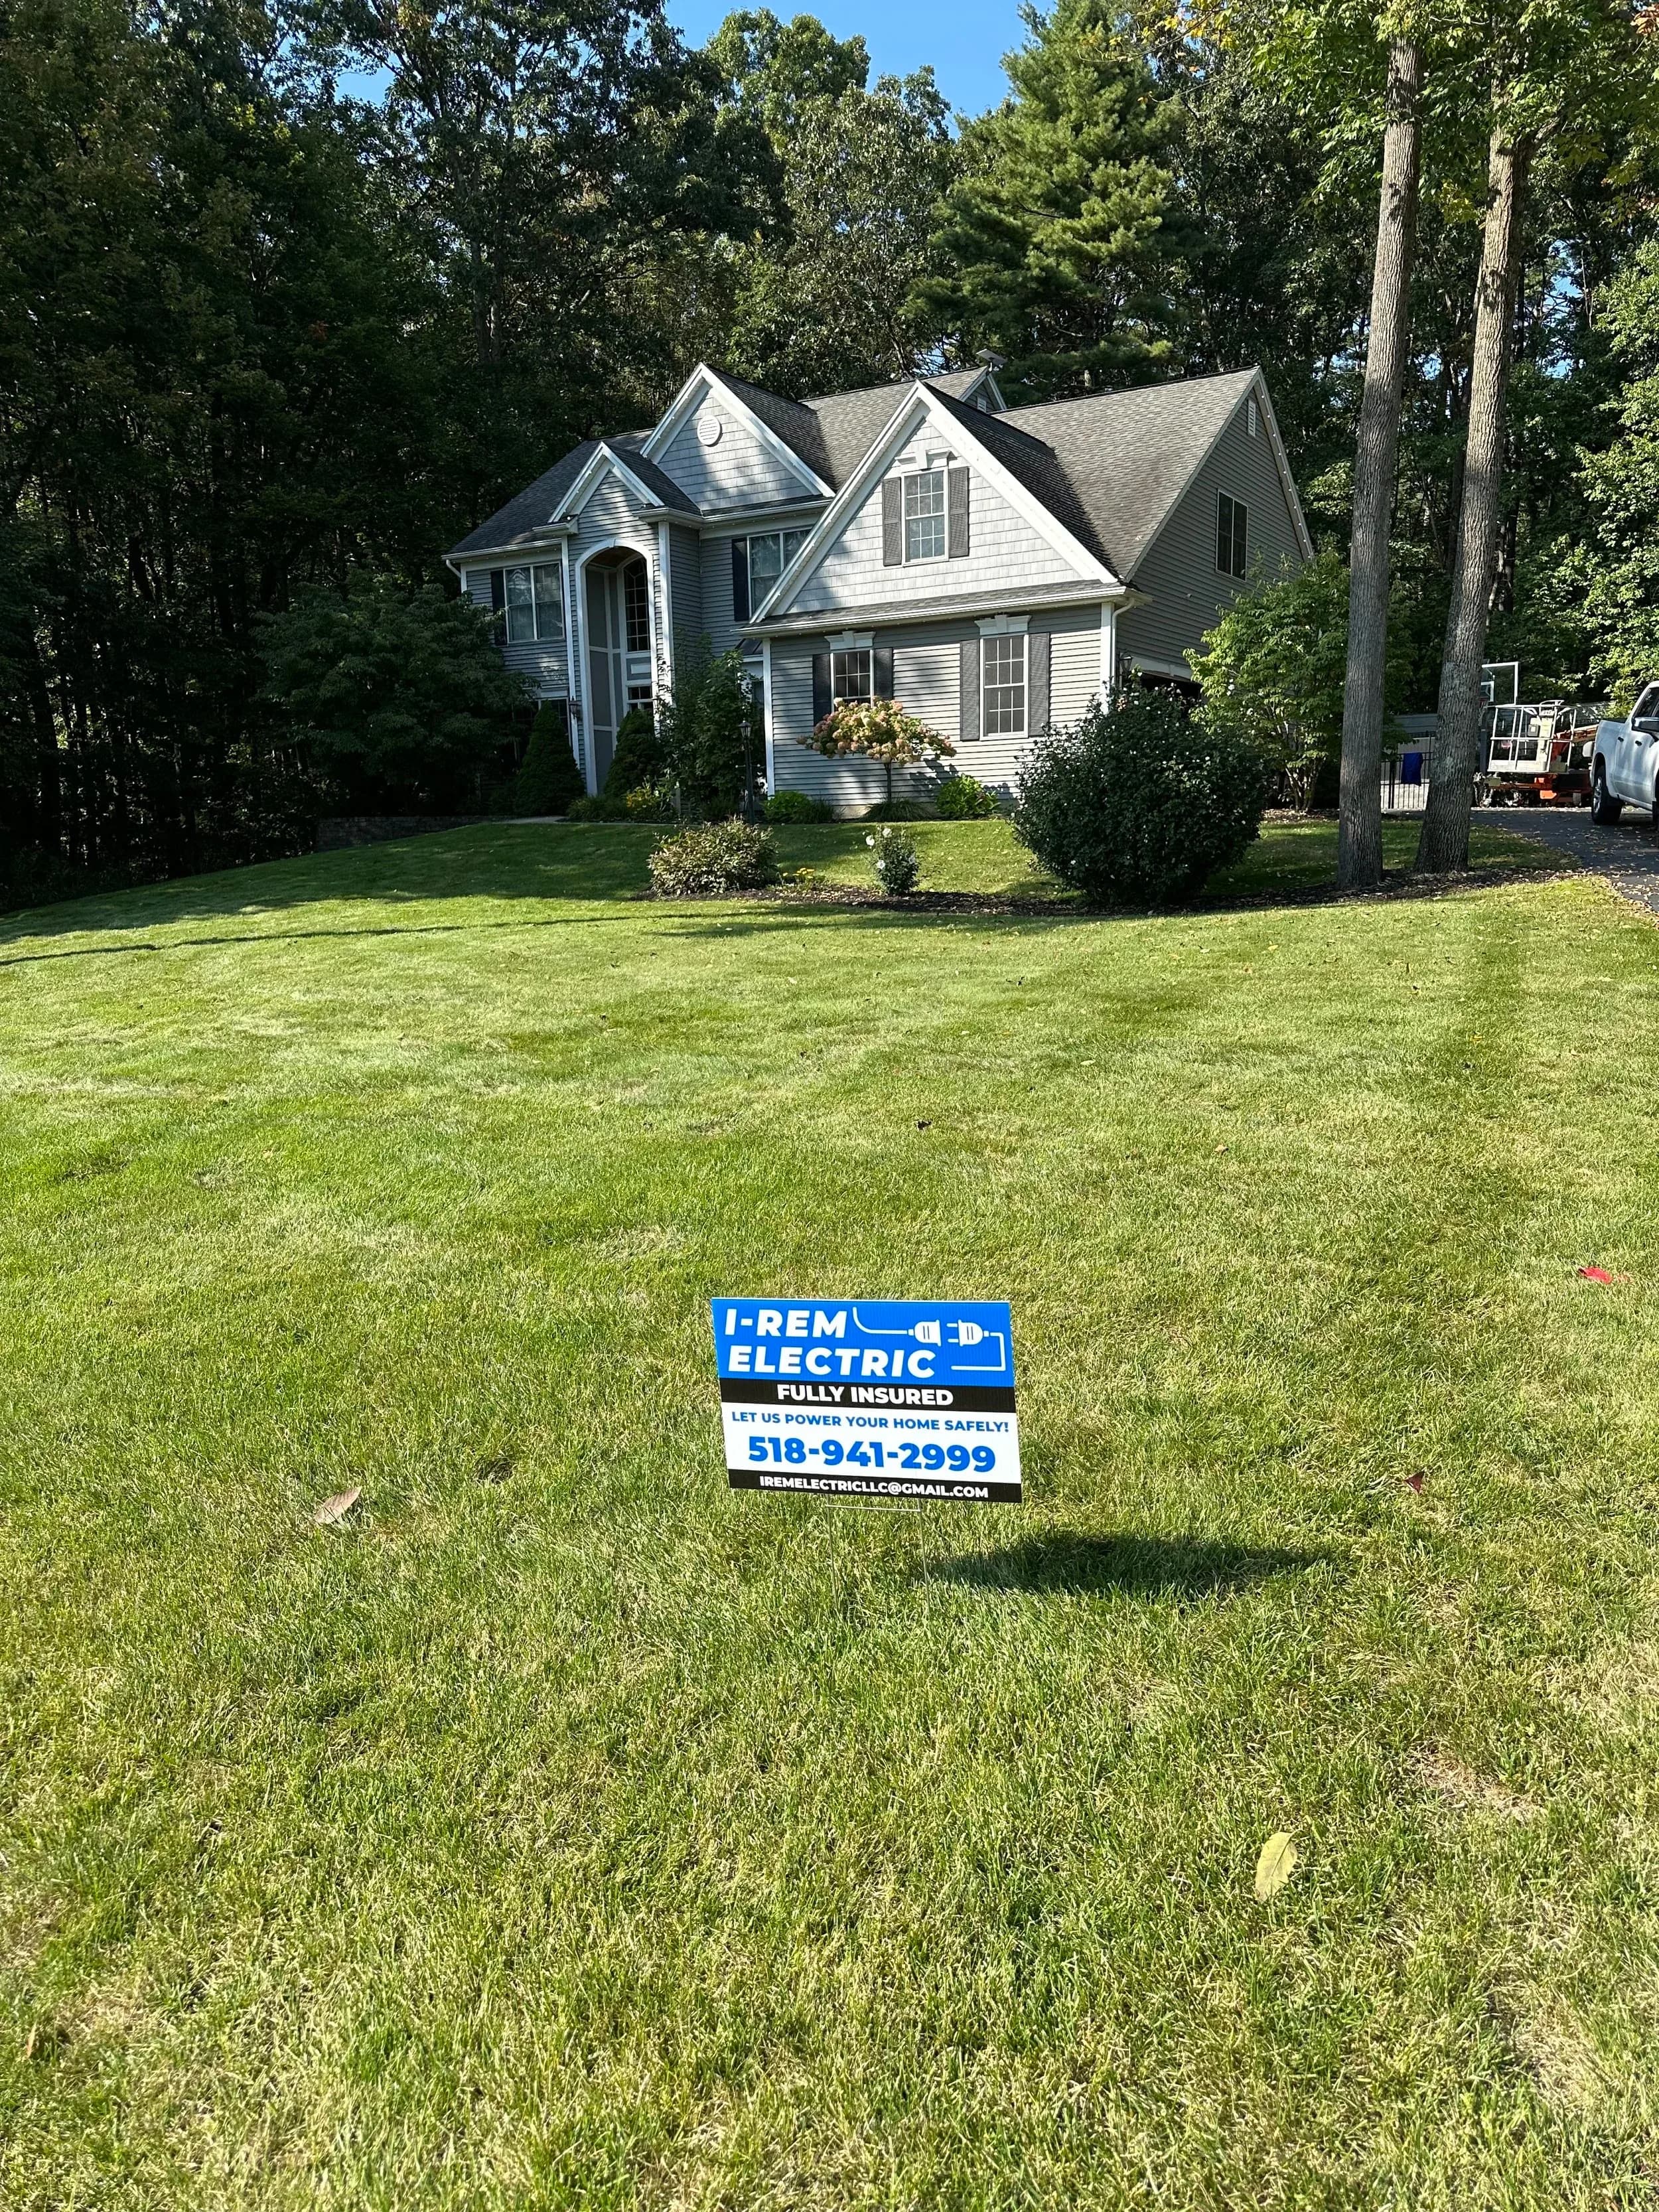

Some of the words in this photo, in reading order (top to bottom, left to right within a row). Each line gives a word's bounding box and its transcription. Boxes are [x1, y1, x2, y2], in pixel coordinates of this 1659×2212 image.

[725, 1308, 847, 1339] I-REM
[728, 1345, 936, 1378] ELECTRIC
[777, 1384, 845, 1402] FULLY
[851, 1387, 954, 1406] INSURED
[732, 1412, 757, 1422] LET
[762, 1412, 780, 1424] US
[786, 1414, 841, 1426] POWER
[845, 1416, 889, 1428] YOUR
[894, 1418, 940, 1430] HOME
[944, 1420, 1009, 1432] SAFELY!
[749, 1436, 996, 1473] 518-941-2999
[760, 1476, 988, 1498] IREMELECTRICLLC@GMAIL.COM
